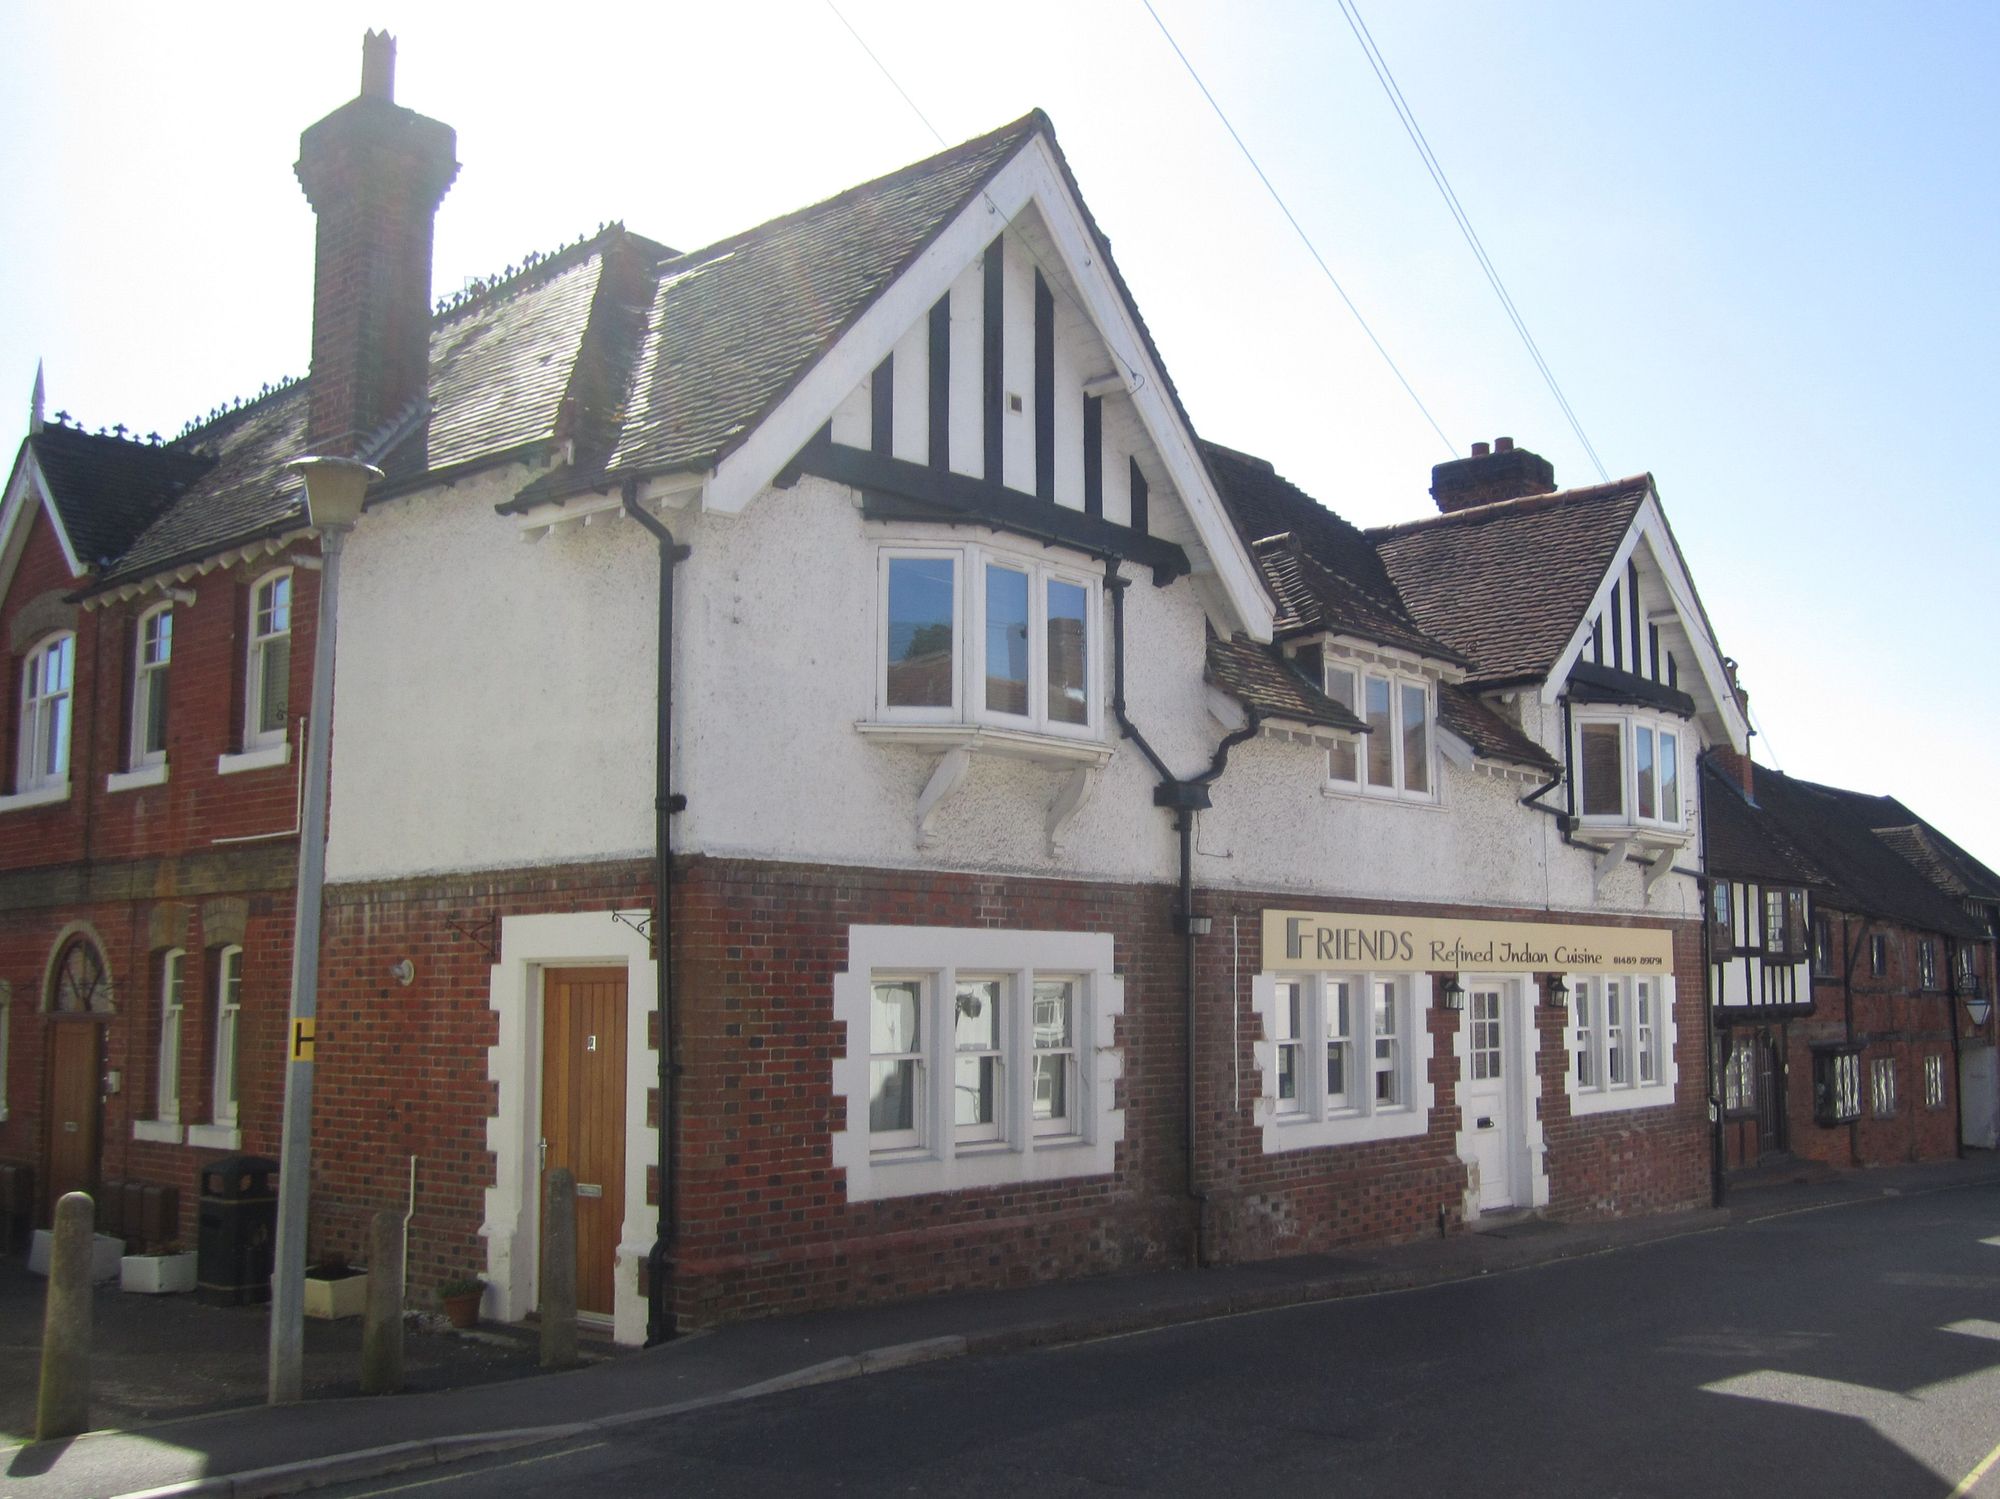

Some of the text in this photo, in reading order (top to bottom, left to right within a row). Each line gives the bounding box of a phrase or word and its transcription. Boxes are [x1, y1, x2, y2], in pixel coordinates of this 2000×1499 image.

[1287, 917, 1414, 962] FRIENDS
[1429, 936, 1493, 969] Refined
[1499, 942, 1549, 964] Indian
[1554, 946, 1603, 964] Cuisine
